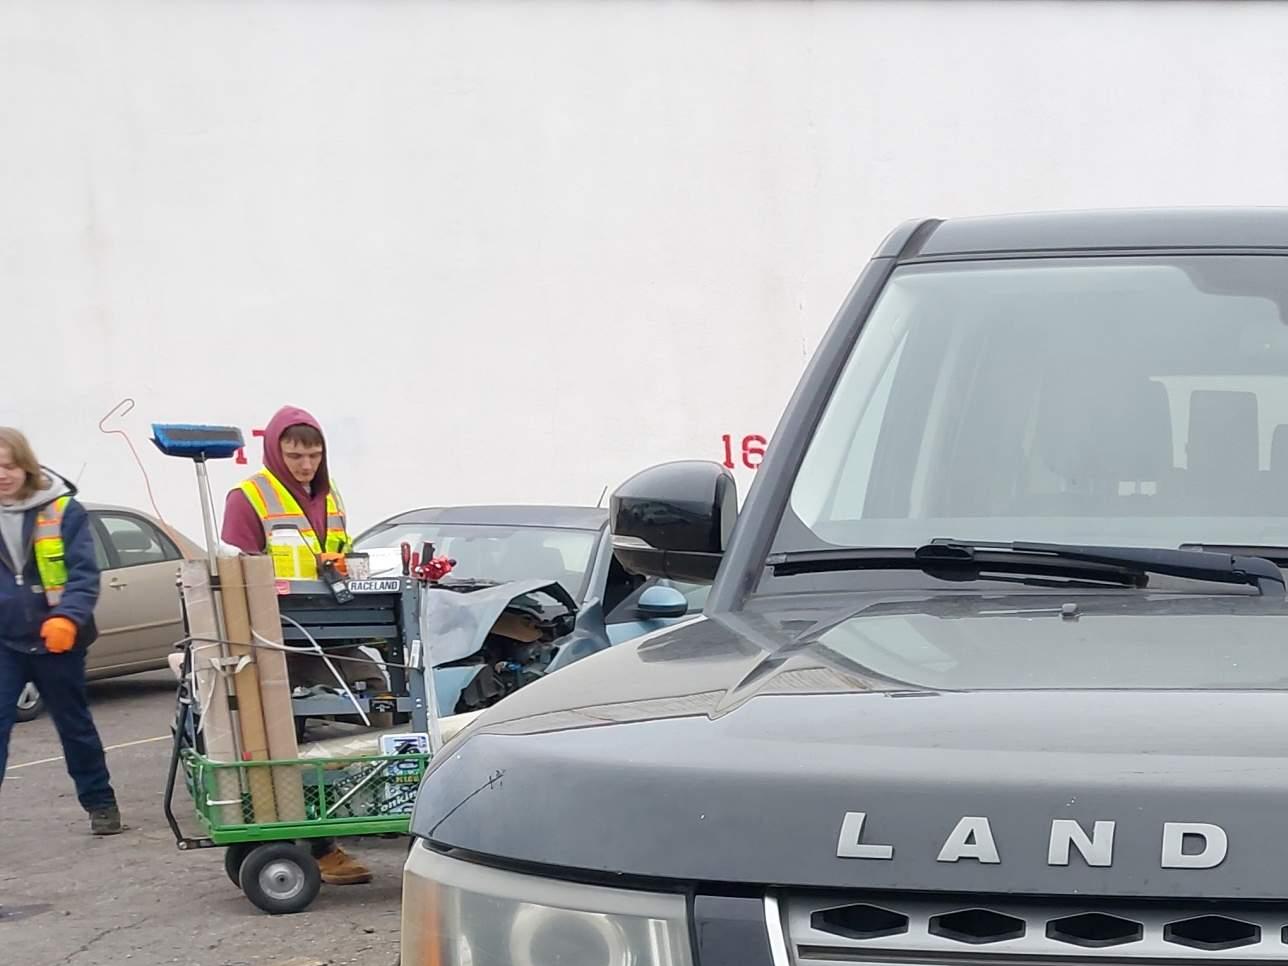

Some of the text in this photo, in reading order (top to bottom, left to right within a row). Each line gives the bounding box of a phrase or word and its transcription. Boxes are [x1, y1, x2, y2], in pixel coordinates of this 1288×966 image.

[721, 434, 768, 469] 16
[350, 581, 398, 591] RACELAND
[836, 811, 1229, 869] LAND
